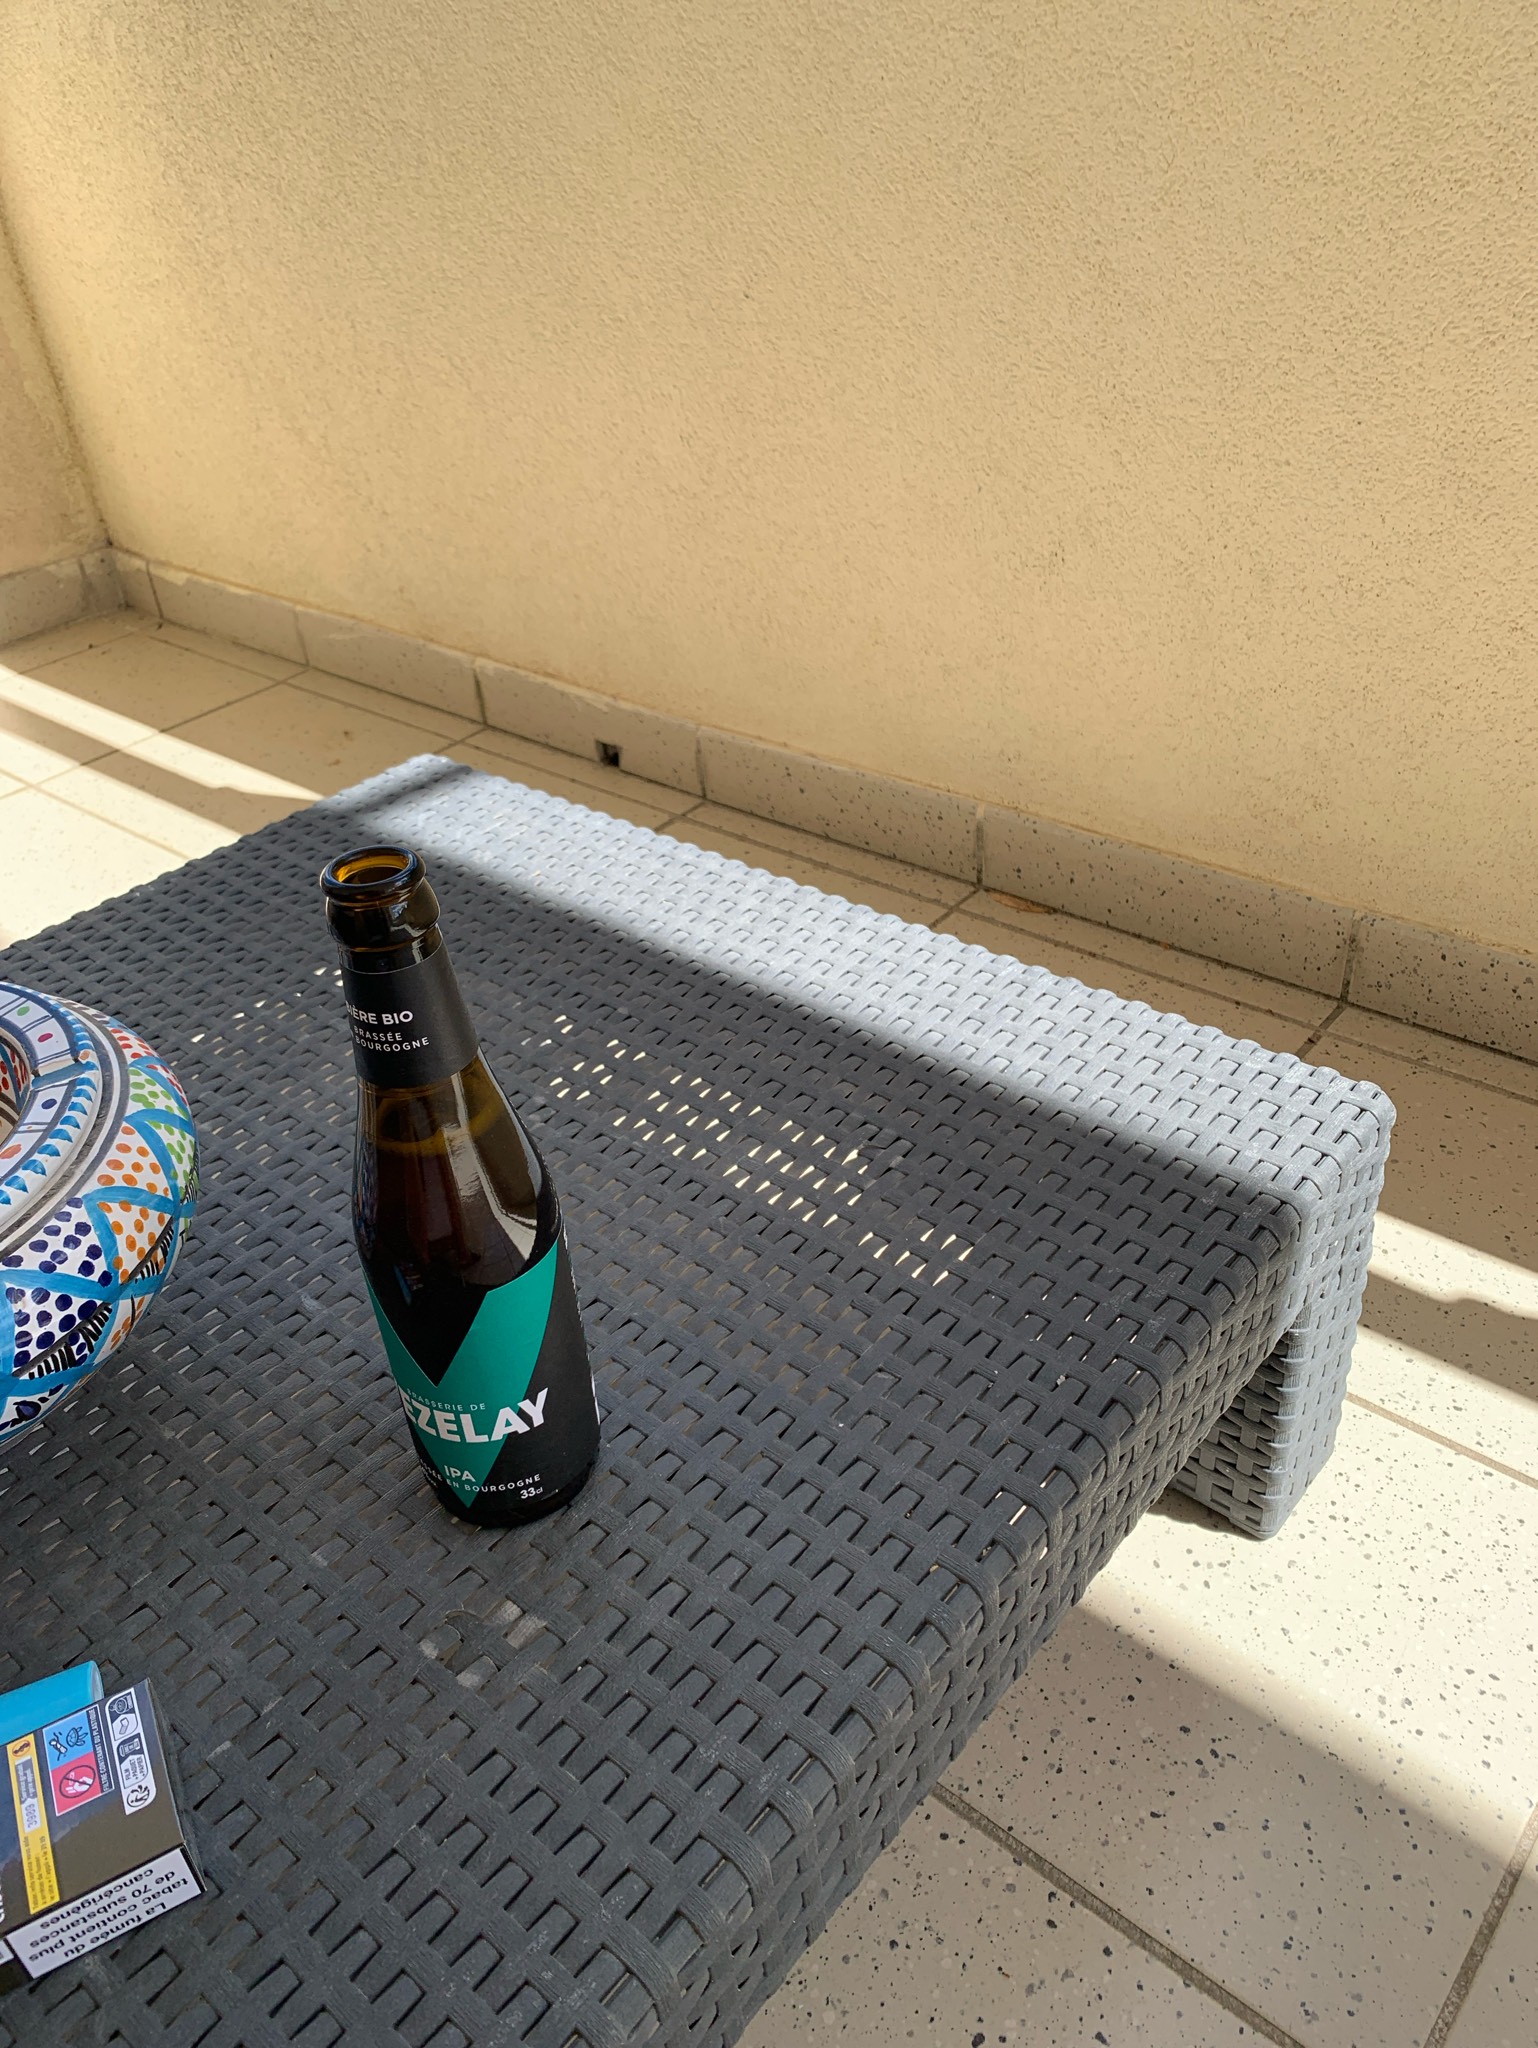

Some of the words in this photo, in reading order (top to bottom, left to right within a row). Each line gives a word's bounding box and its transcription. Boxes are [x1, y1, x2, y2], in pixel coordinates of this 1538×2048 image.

[381, 1010, 413, 1025] BIO
[353, 1025, 402, 1042] BRASSÉE
[355, 1035, 430, 1052] BOURGOGNE
[406, 1388, 463, 1412] BRASSERIE
[470, 1402, 486, 1412] DE
[398, 1386, 548, 1443] EZELAY
[443, 1464, 476, 1483] IPA
[446, 1478, 460, 1489] EN
[464, 1473, 541, 1493] BOURGOGNE
[520, 1486, 544, 1500] 33cl
[88, 1709, 99, 1736] PLASTIQUE
[156, 1872, 174, 1884] de
[41, 1870, 153, 1929] cancérigènes
[132, 1885, 151, 1897] 70
[143, 1879, 188, 1904] tabac
[146, 1903, 168, 1916] La
[30, 1897, 127, 1947] substances
[69, 1905, 137, 1942] contient
[91, 1915, 144, 1943] fumée
[29, 1940, 64, 1961] plus
[64, 1944, 85, 1957] du
